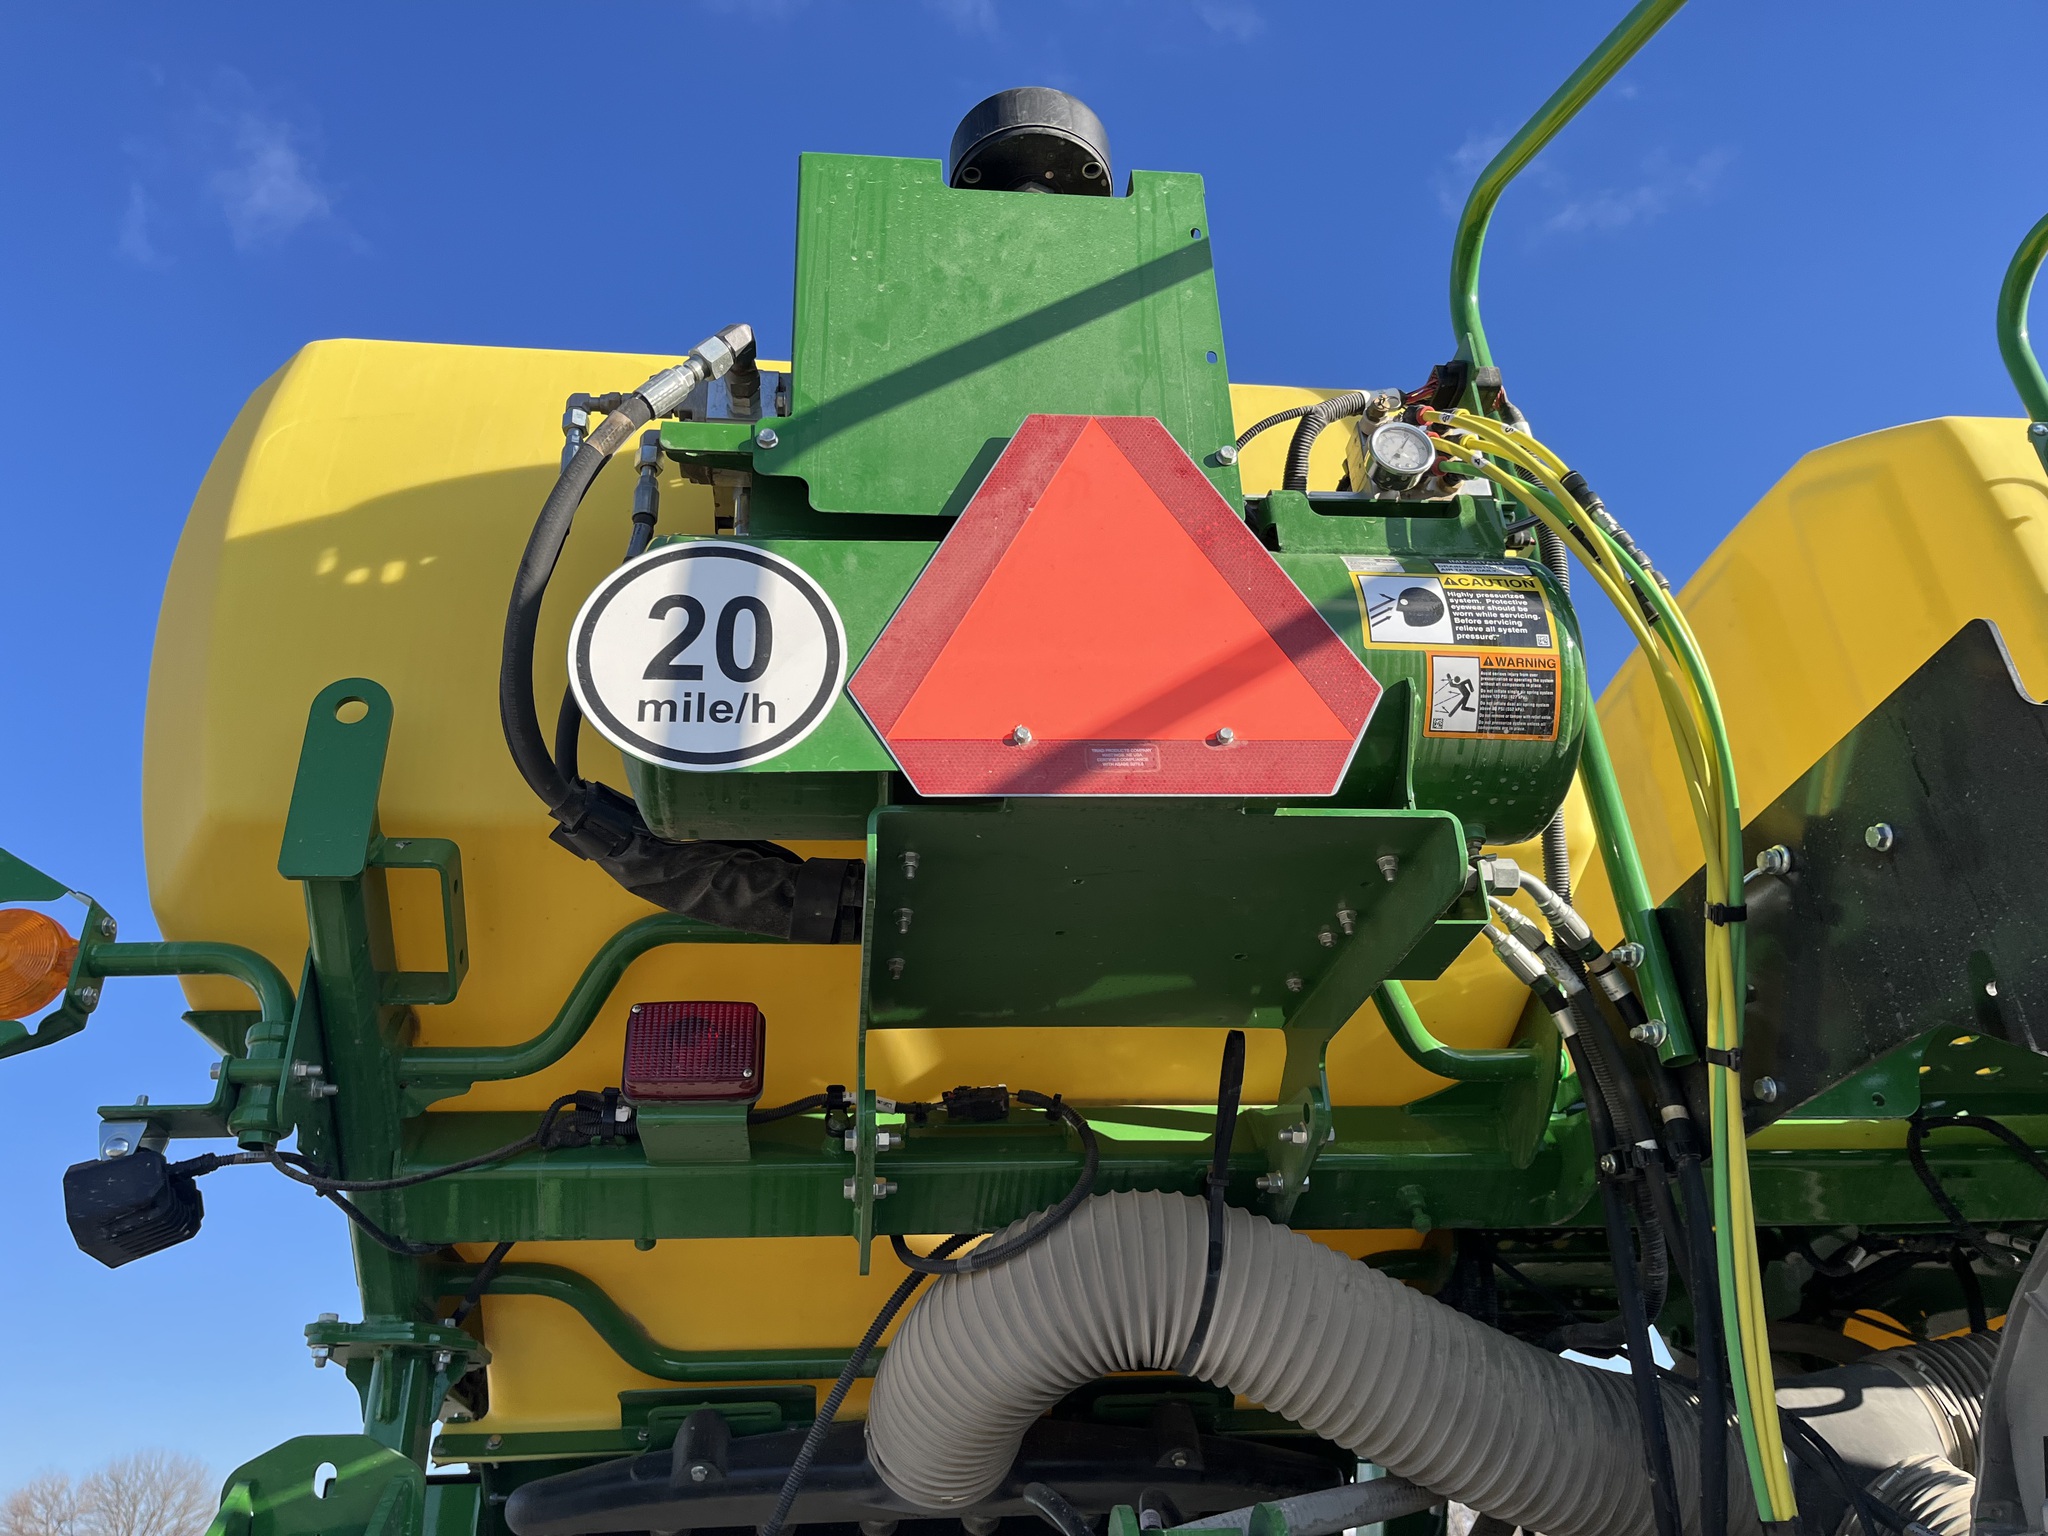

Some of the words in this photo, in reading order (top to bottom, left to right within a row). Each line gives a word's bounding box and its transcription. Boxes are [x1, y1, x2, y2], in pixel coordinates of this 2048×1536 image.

[1458, 578, 1535, 588] CAUTION
[642, 594, 774, 683] 20
[1495, 657, 1556, 668] WARNING
[637, 692, 776, 724] mile/h
